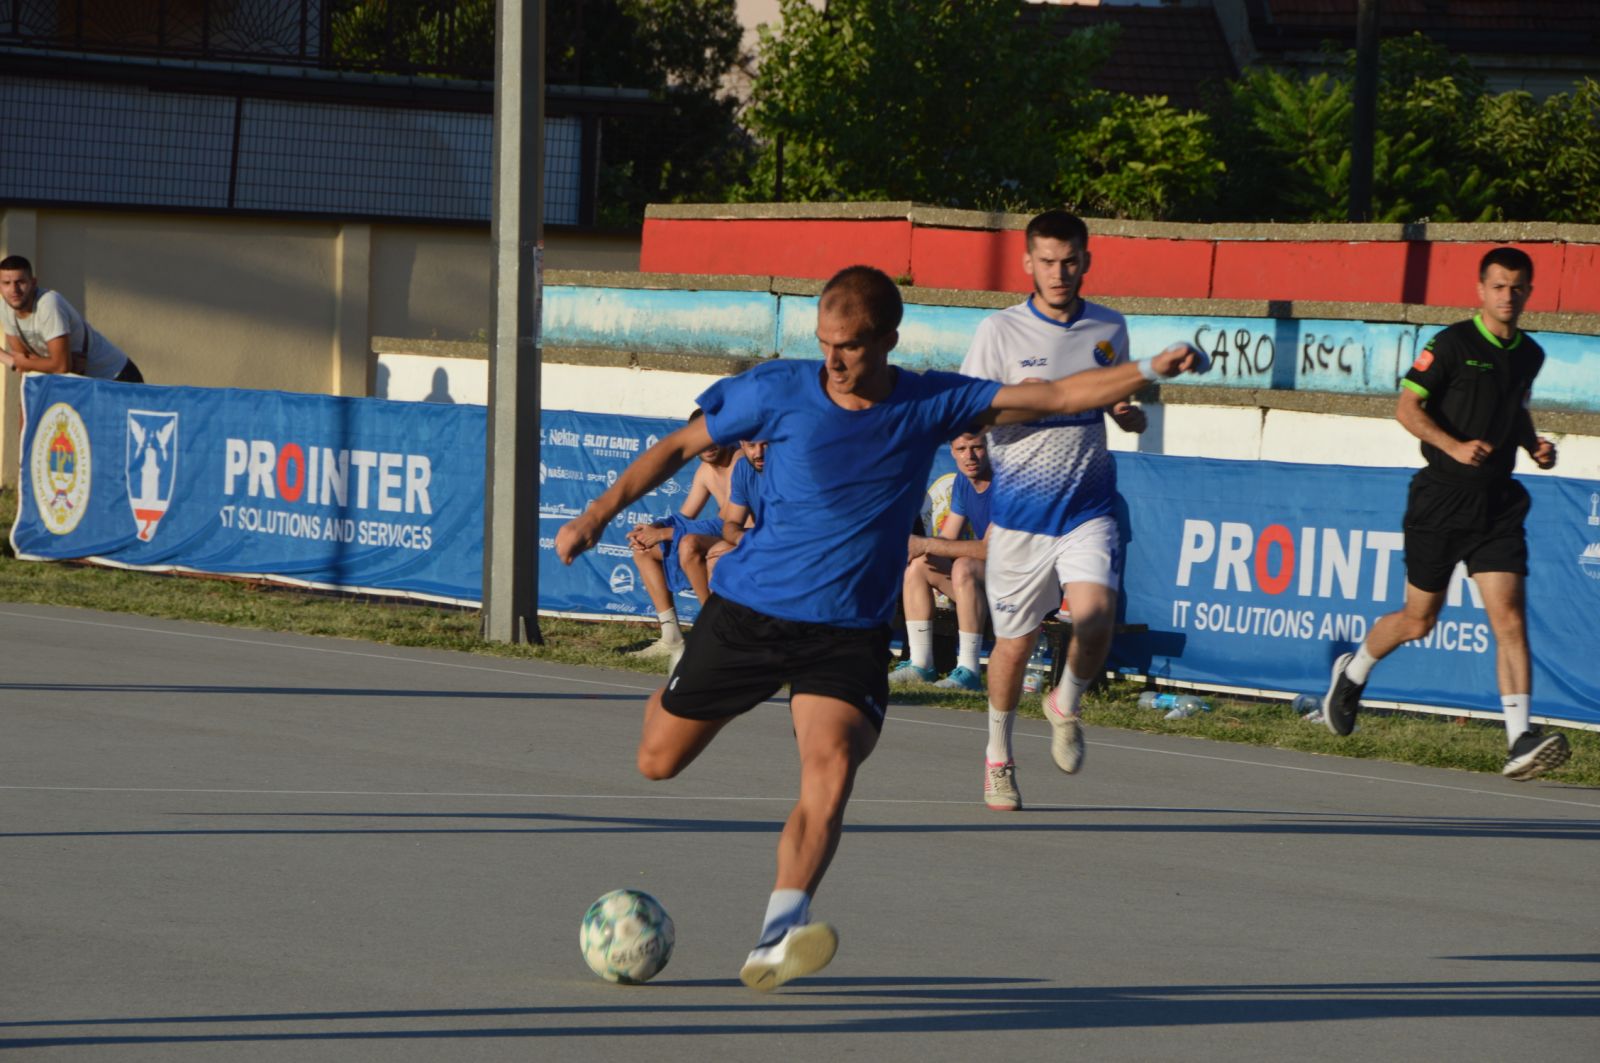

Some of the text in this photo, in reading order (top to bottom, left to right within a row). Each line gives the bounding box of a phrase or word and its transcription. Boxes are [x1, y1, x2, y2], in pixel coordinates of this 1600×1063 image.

[582, 433, 640, 452] SLOT GAME
[224, 438, 433, 515] PROINTER
[220, 505, 432, 551] IT SOLUTIONS AND SERVICES
[1175, 518, 1486, 609] PROINTR
[1173, 600, 1191, 628] IT
[1195, 601, 1314, 640] SOLUTIONS
[1318, 612, 1366, 644] AND
